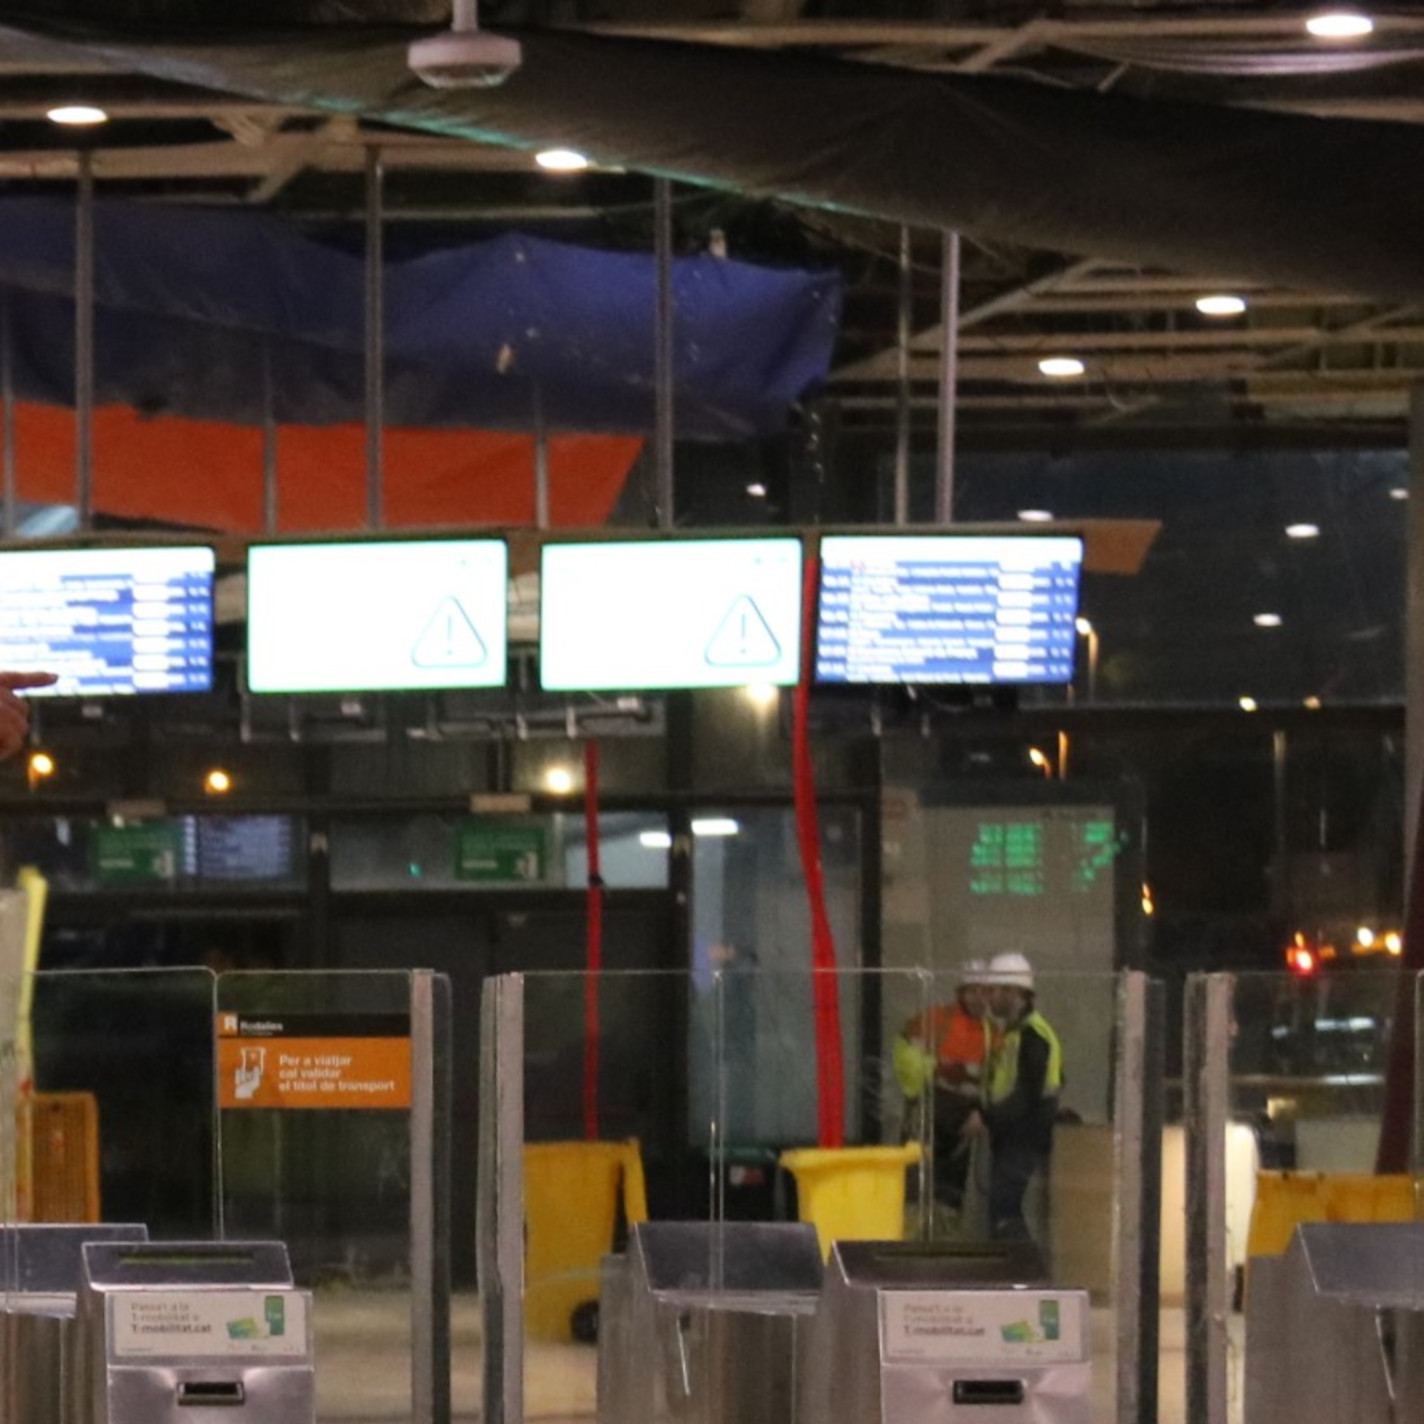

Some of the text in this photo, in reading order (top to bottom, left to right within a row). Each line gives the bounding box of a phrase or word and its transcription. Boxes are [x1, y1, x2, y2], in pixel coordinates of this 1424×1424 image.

[240, 1020, 284, 1031] Rodalies
[279, 1054, 352, 1068] Per a viatjar
[279, 1067, 342, 1079] cal validar
[278, 1080, 291, 1091] el
[320, 1080, 335, 1091] de
[338, 1080, 395, 1093] transport
